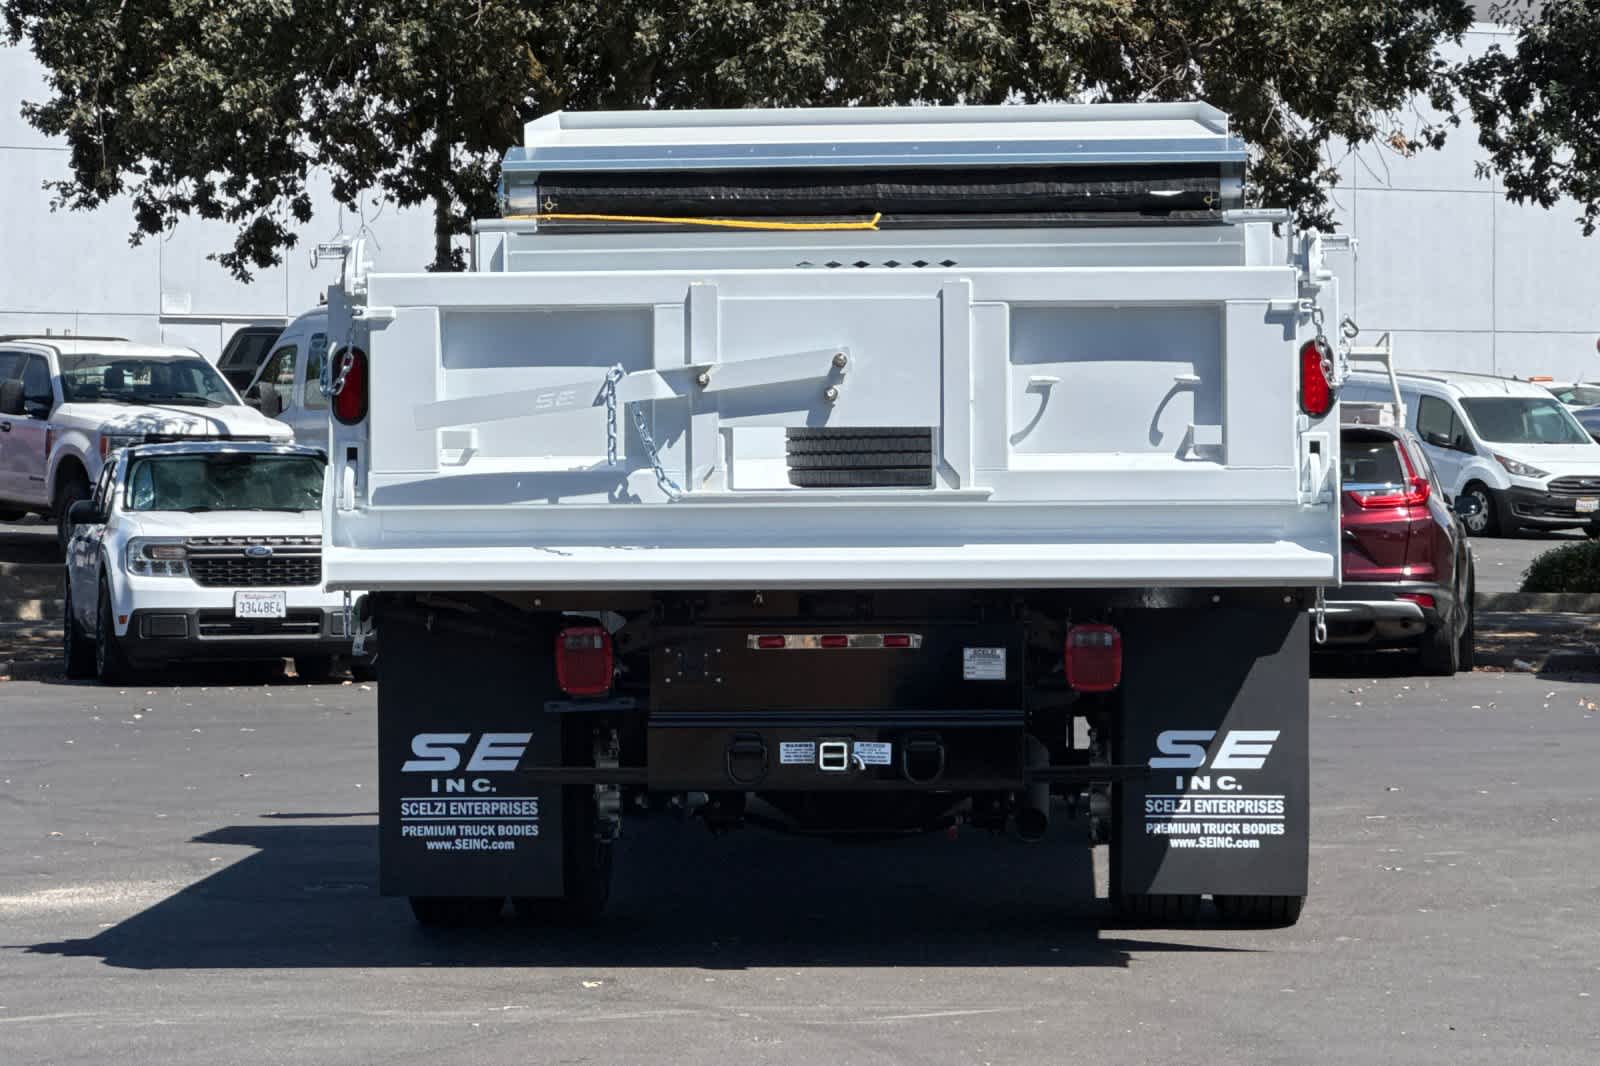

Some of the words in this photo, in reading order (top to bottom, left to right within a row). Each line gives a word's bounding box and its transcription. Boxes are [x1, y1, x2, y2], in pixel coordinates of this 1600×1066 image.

[535, 391, 576, 409] SE
[401, 733, 533, 772] SE
[1148, 730, 1281, 769] SE
[431, 778, 497, 793] INC.
[1175, 775, 1243, 791] INC.
[401, 802, 447, 816] SCELZI
[449, 801, 539, 816] ENTERPRISES
[1145, 799, 1192, 814] SCELZI
[1193, 799, 1285, 814] ENTERPRISES
[402, 825, 457, 837] PREMIUM
[459, 825, 496, 837] TRUCK
[497, 824, 539, 836] BODIES
[1146, 823, 1201, 835] PREMIUM
[1202, 823, 1241, 835] TRUCK
[1242, 822, 1285, 835] BODIES
[426, 838, 515, 850] www.SEINC.com
[1169, 836, 1261, 849] www.SEINC.com
